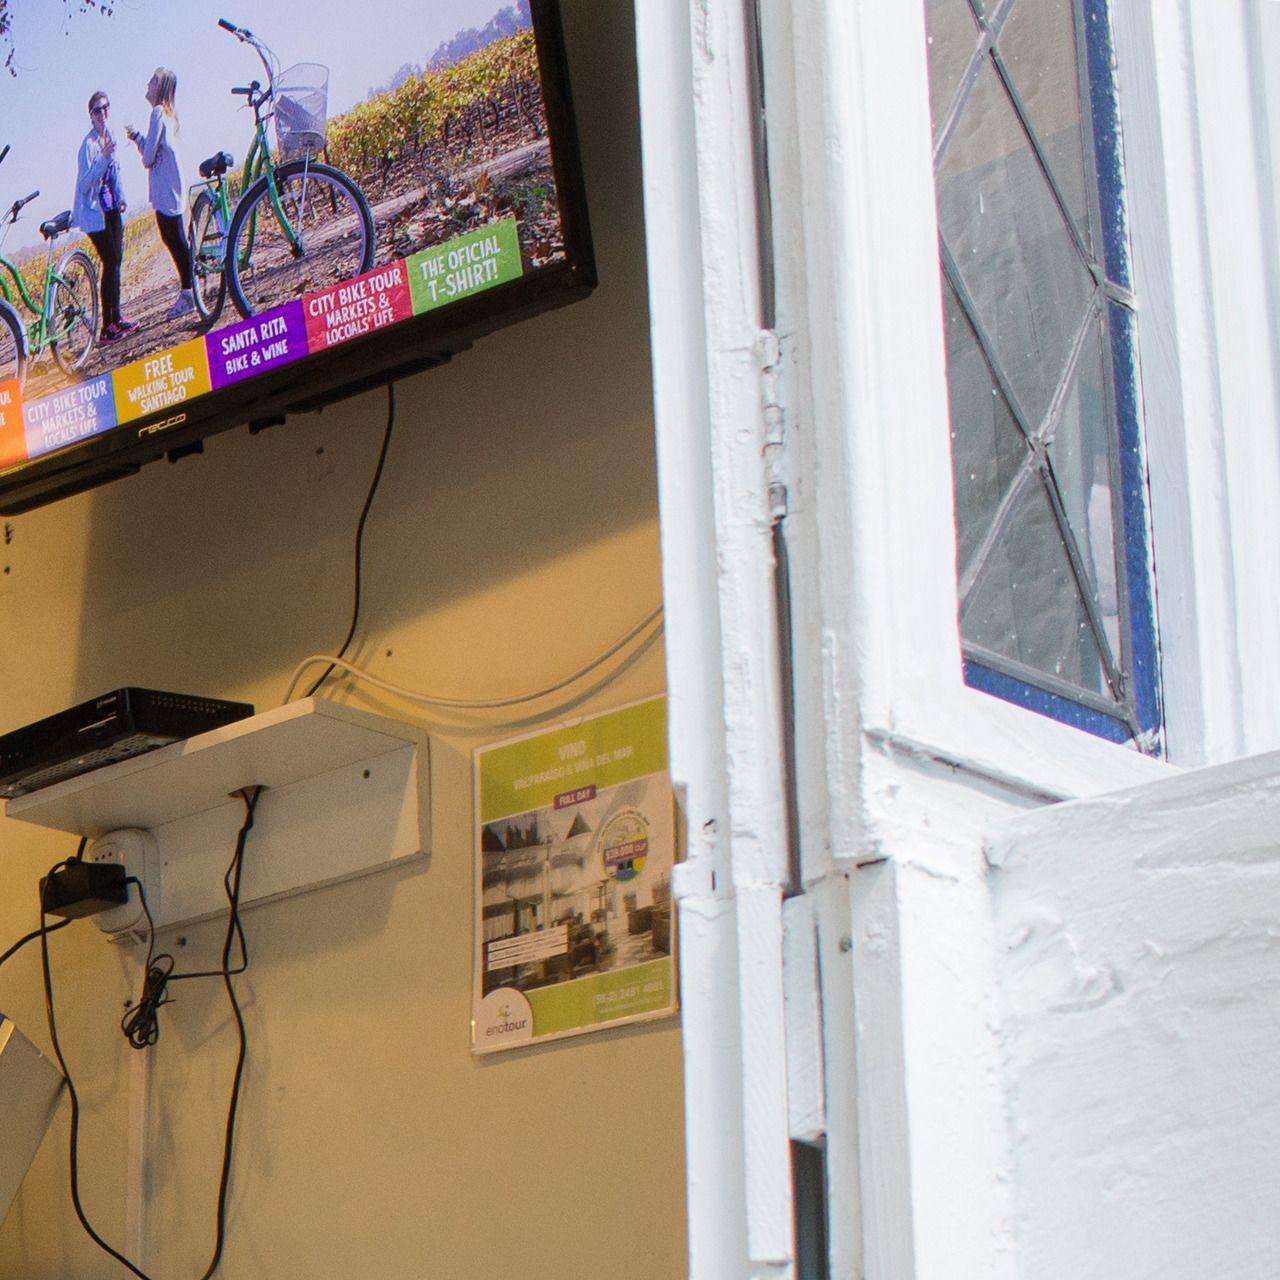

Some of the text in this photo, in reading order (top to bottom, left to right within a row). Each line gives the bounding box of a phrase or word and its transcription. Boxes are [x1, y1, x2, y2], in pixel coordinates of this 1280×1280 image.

[420, 235, 501, 281] THE OFICIAL
[309, 268, 402, 317] CITY BIKE TOUR
[427, 258, 498, 302] T-SHIRT!
[326, 293, 390, 329] MARKETS &
[374, 308, 394, 327] LIFE
[221, 316, 288, 355] SANTA RITA
[144, 354, 174, 381] FREE
[225, 339, 288, 375] BIKE & WINE
[27, 380, 108, 423] CITY BIKE TOUR
[127, 367, 195, 403] WALKING TOUR
[140, 385, 187, 414] SANTIAGO
[42, 402, 97, 434] MARKETS &
[79, 418, 99, 436] LIFE
[559, 790, 591, 806] FULL DAY
[486, 1019, 527, 1036] enotour
